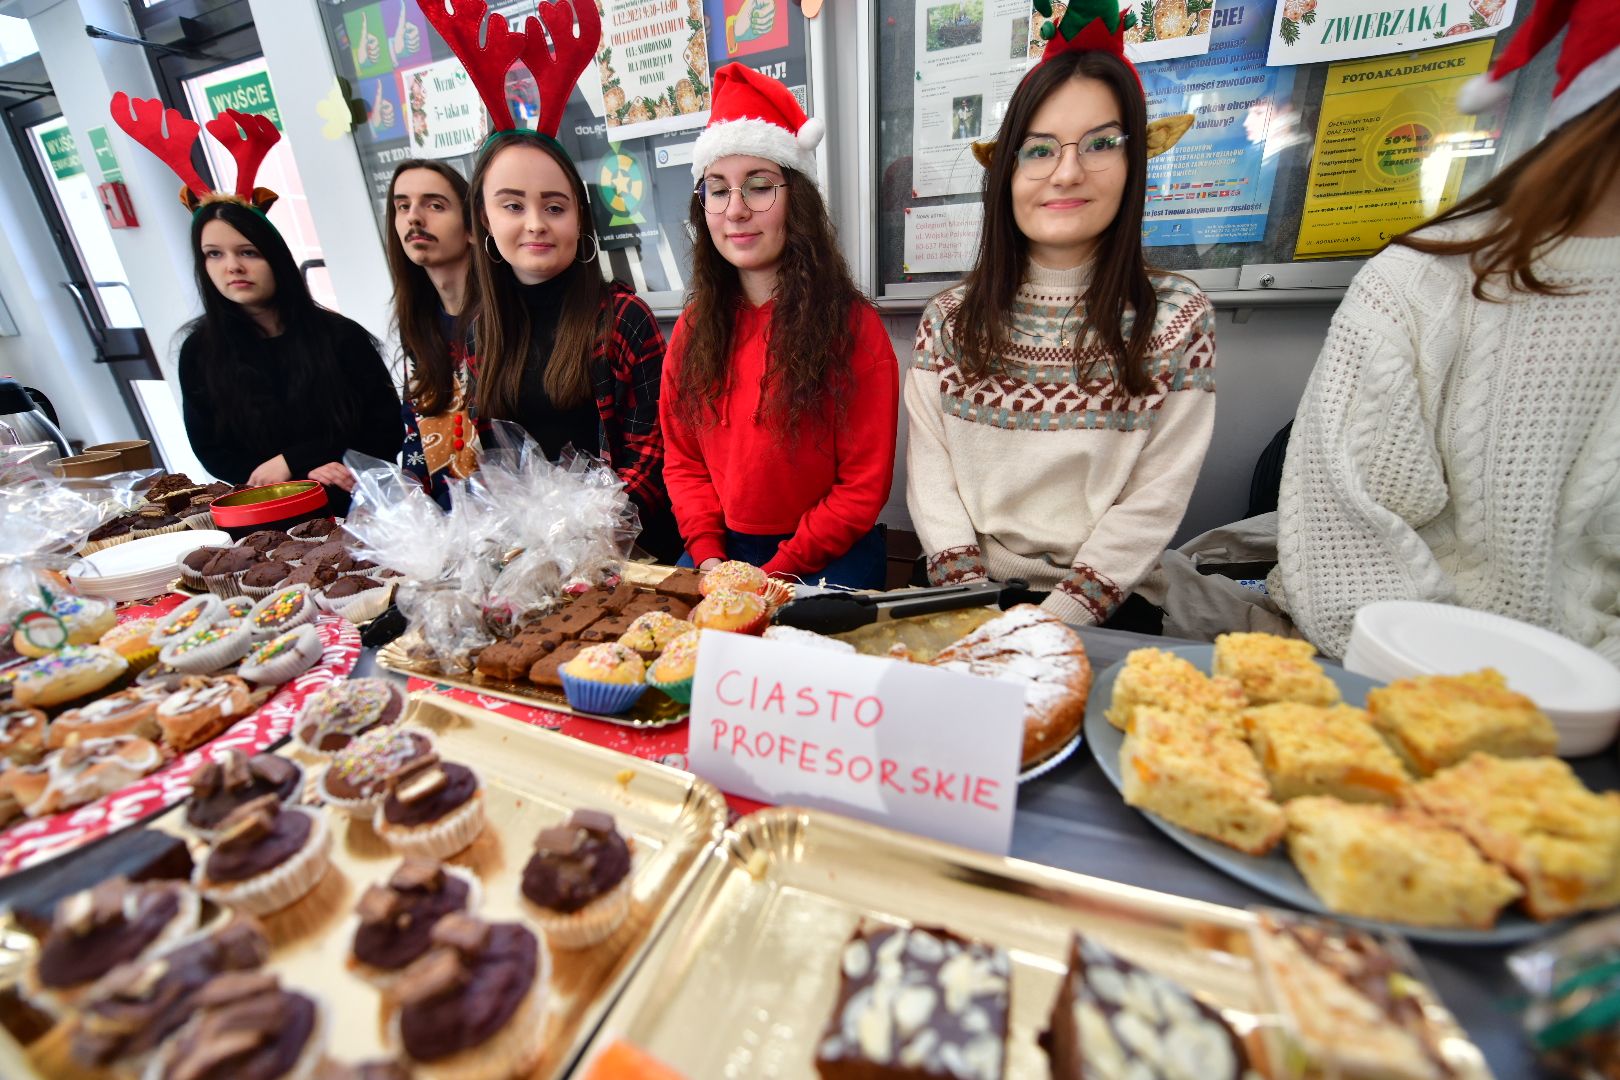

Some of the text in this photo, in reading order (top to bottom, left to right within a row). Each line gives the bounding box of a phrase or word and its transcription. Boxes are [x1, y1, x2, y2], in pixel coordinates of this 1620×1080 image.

[1320, 3, 1447, 44] ZWIERZAKA
[611, 17, 684, 46] COLLEGIUM MAXIMUM
[638, 38, 672, 55] SCHRONISKO
[1182, 56, 1229, 69] metodami
[1341, 57, 1466, 84] FOTOAKADEMICKE
[639, 71, 665, 85] POZNANIU
[1156, 81, 1216, 96] umiejętności
[1216, 75, 1266, 88] zawodowe
[212, 83, 271, 113] WYJŚCIE
[1196, 116, 1235, 129] kultury?
[1384, 134, 1429, 145] 50% NA
[1378, 145, 1429, 157] WSZYSTKIE
[1383, 158, 1421, 168] ZDJĘCIA
[916, 221, 947, 231] Collegium
[925, 231, 948, 241] Wojska
[949, 229, 981, 239] Polskiego
[916, 241, 962, 251] 60-637 Poznań
[715, 669, 884, 728] CIASTO
[710, 718, 1001, 812] PROFESORSKIE
